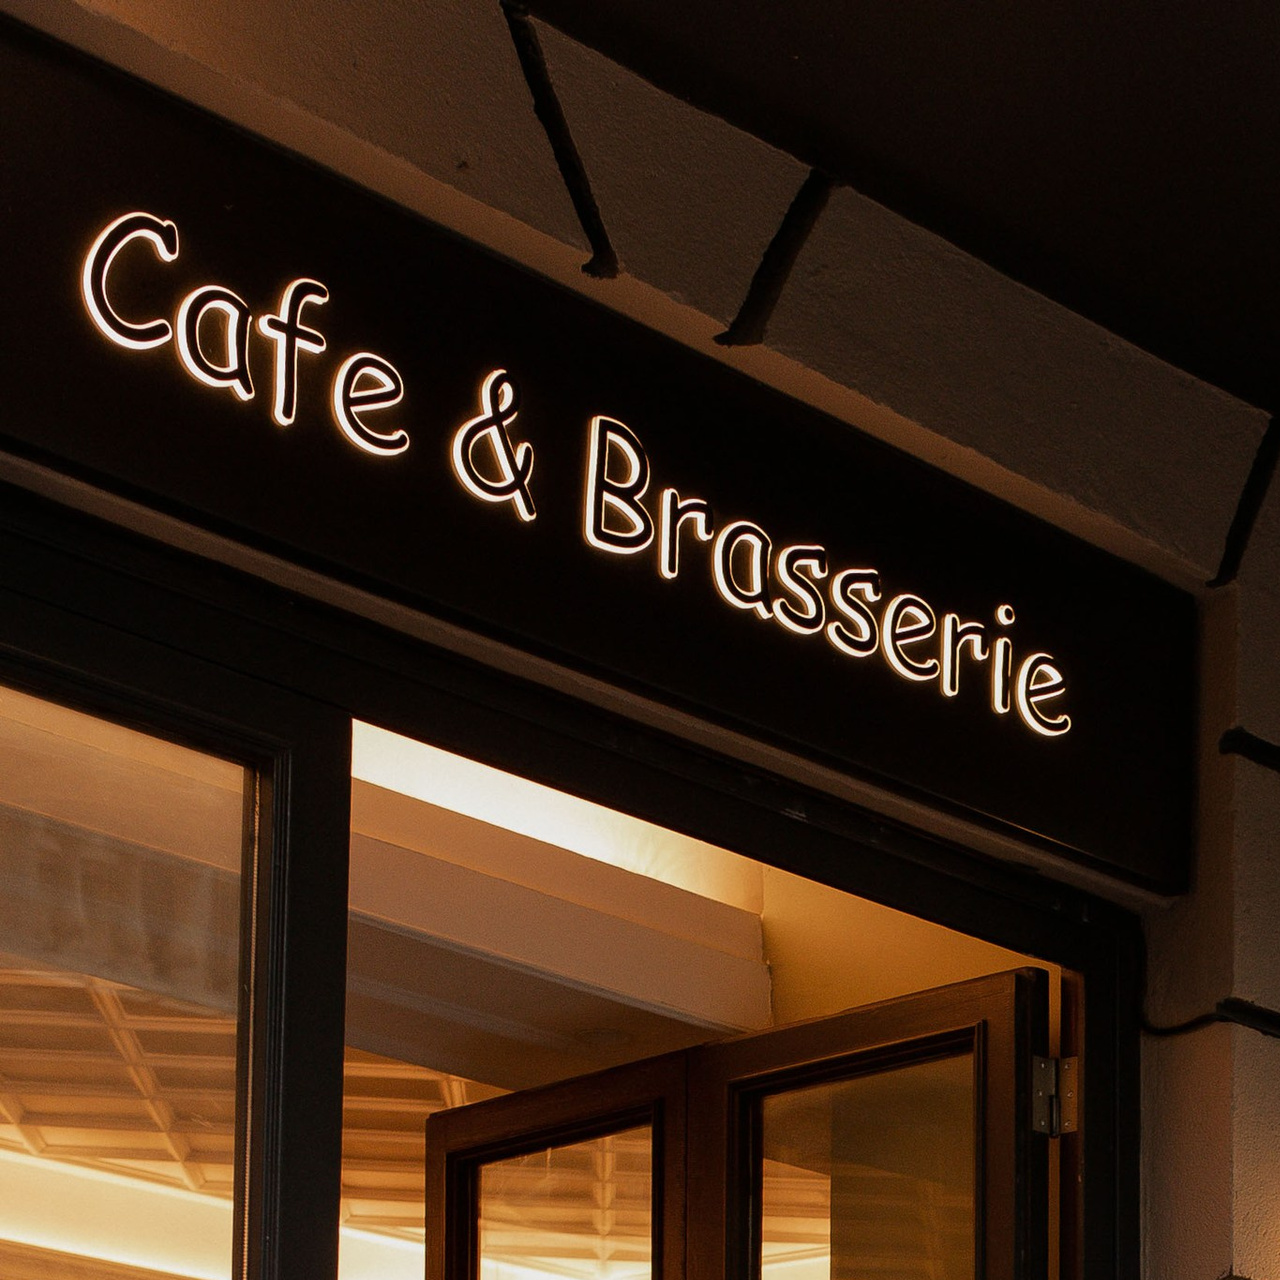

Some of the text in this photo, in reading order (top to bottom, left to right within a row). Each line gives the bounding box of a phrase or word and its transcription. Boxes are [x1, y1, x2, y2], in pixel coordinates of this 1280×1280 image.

[82, 211, 1072, 736] Cafe & Brasserie
